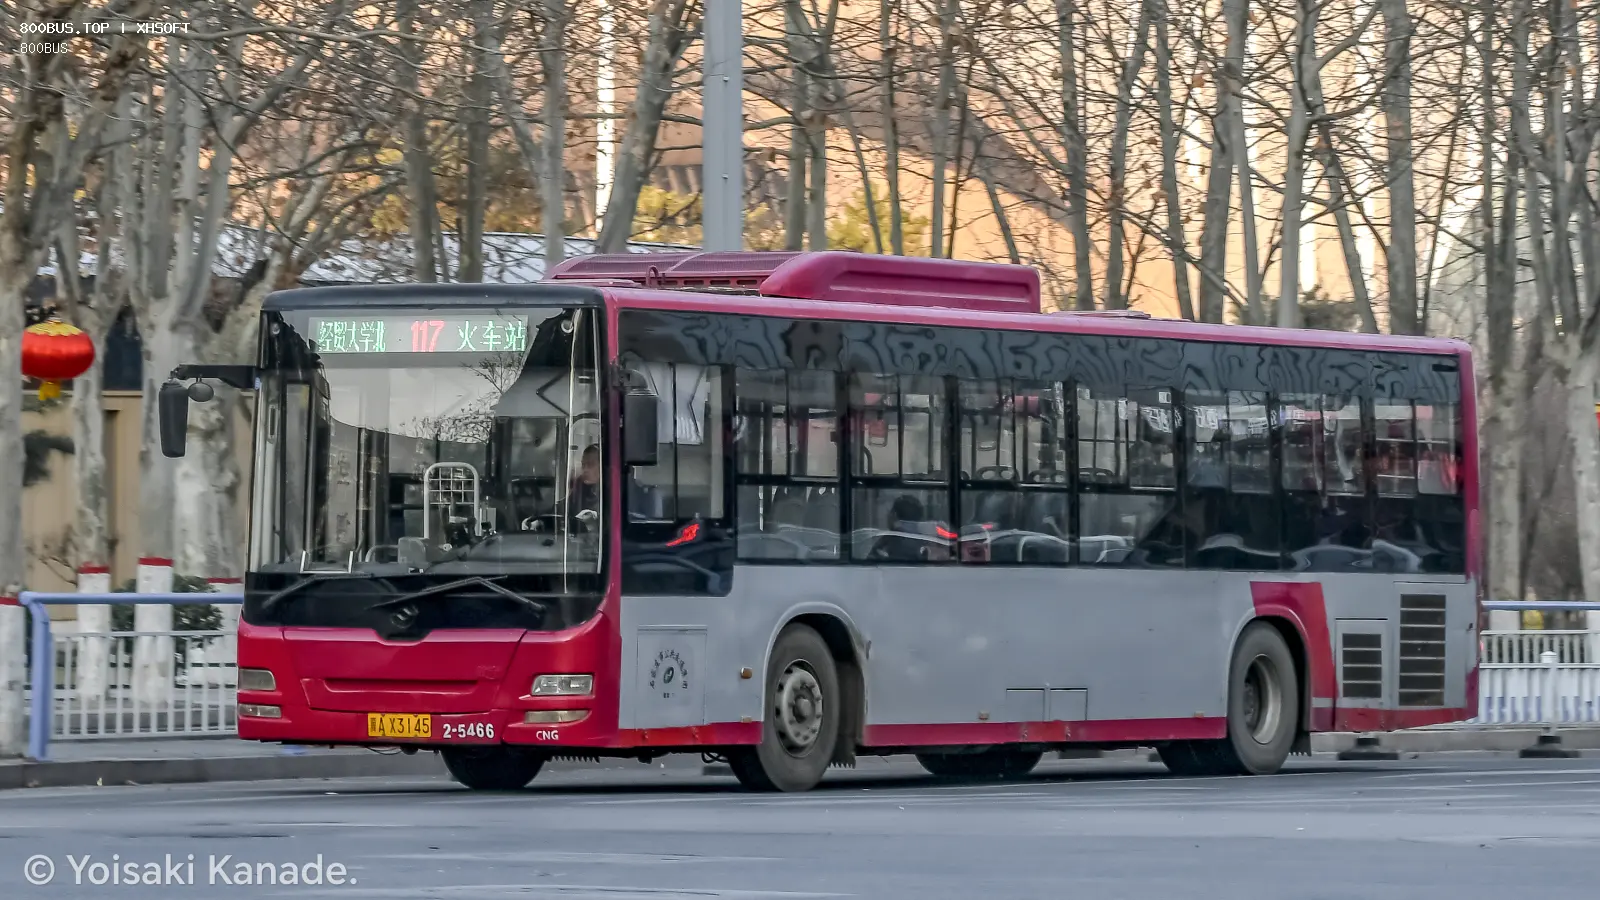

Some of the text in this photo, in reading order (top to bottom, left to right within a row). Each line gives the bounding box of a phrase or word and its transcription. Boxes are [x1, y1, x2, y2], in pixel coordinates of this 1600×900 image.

[411, 320, 445, 352] 117
[456, 320, 526, 352] 火车站
[442, 723, 495, 738] 2-5466
[536, 730, 559, 740] CNG
